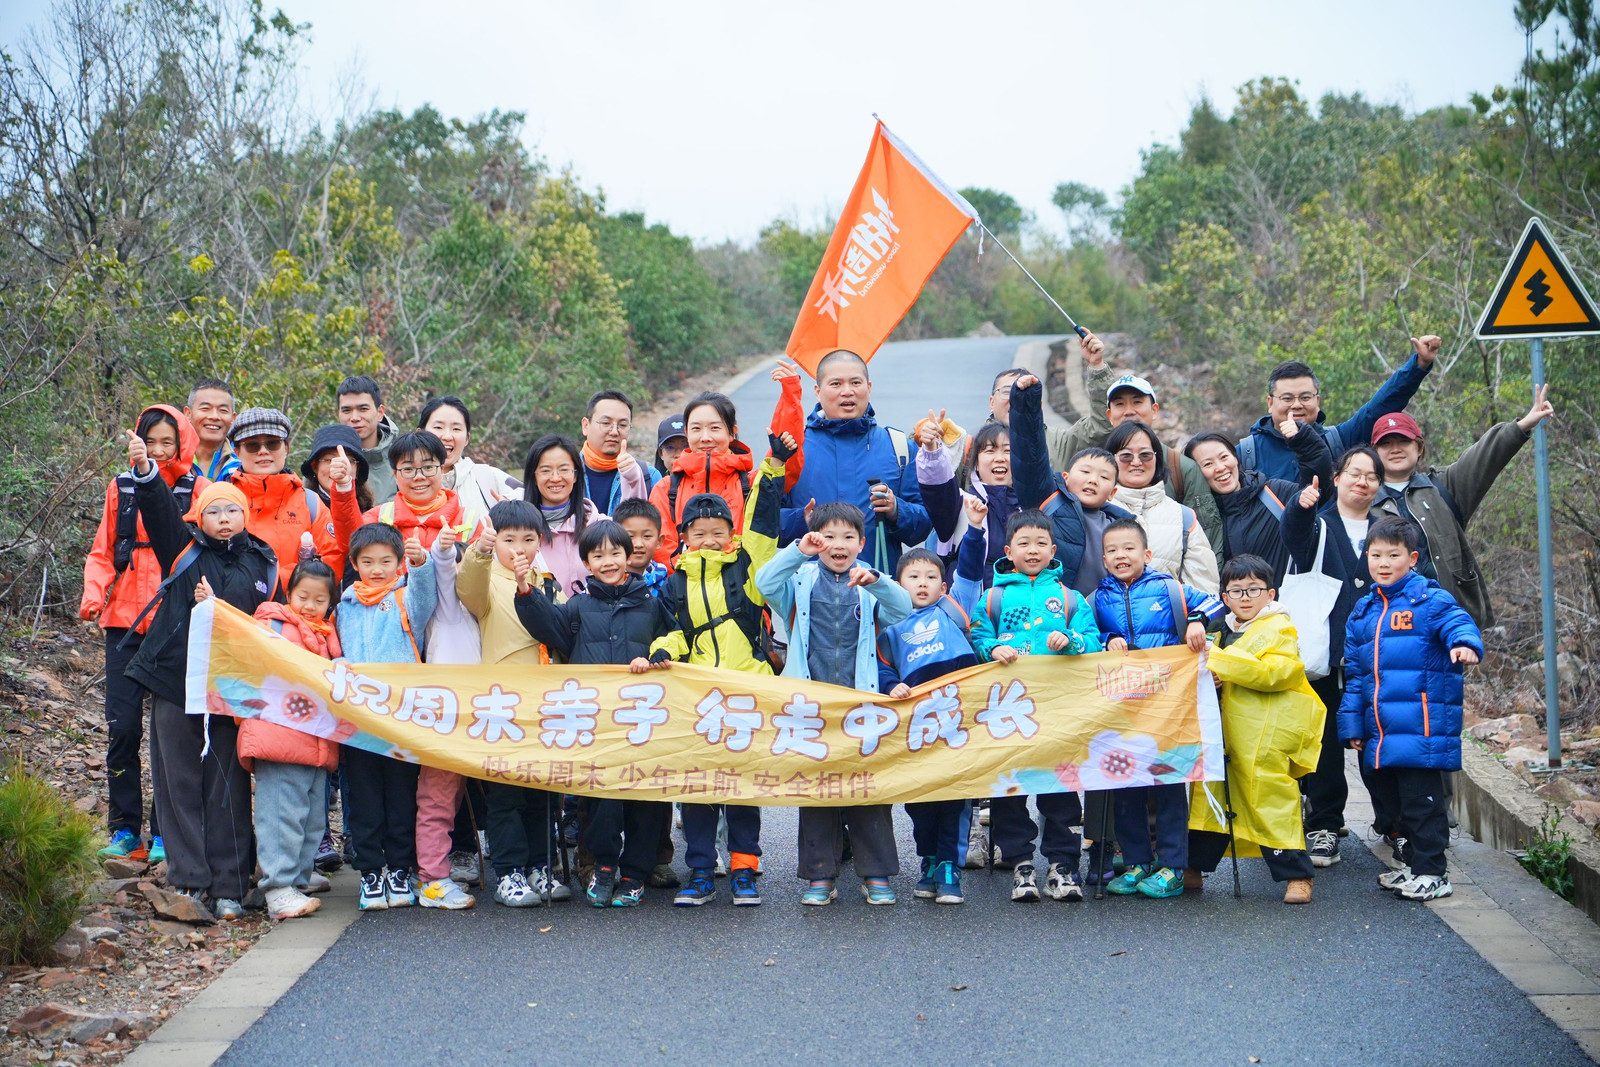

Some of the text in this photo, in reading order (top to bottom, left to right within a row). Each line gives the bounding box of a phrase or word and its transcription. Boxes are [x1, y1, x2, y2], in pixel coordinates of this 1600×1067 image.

[1390, 610, 1413, 631] 02
[907, 641, 945, 663] adidas
[694, 679, 1040, 761] 行走中成长
[481, 756, 877, 799] 快乐周末 少年启航 安全相伴
